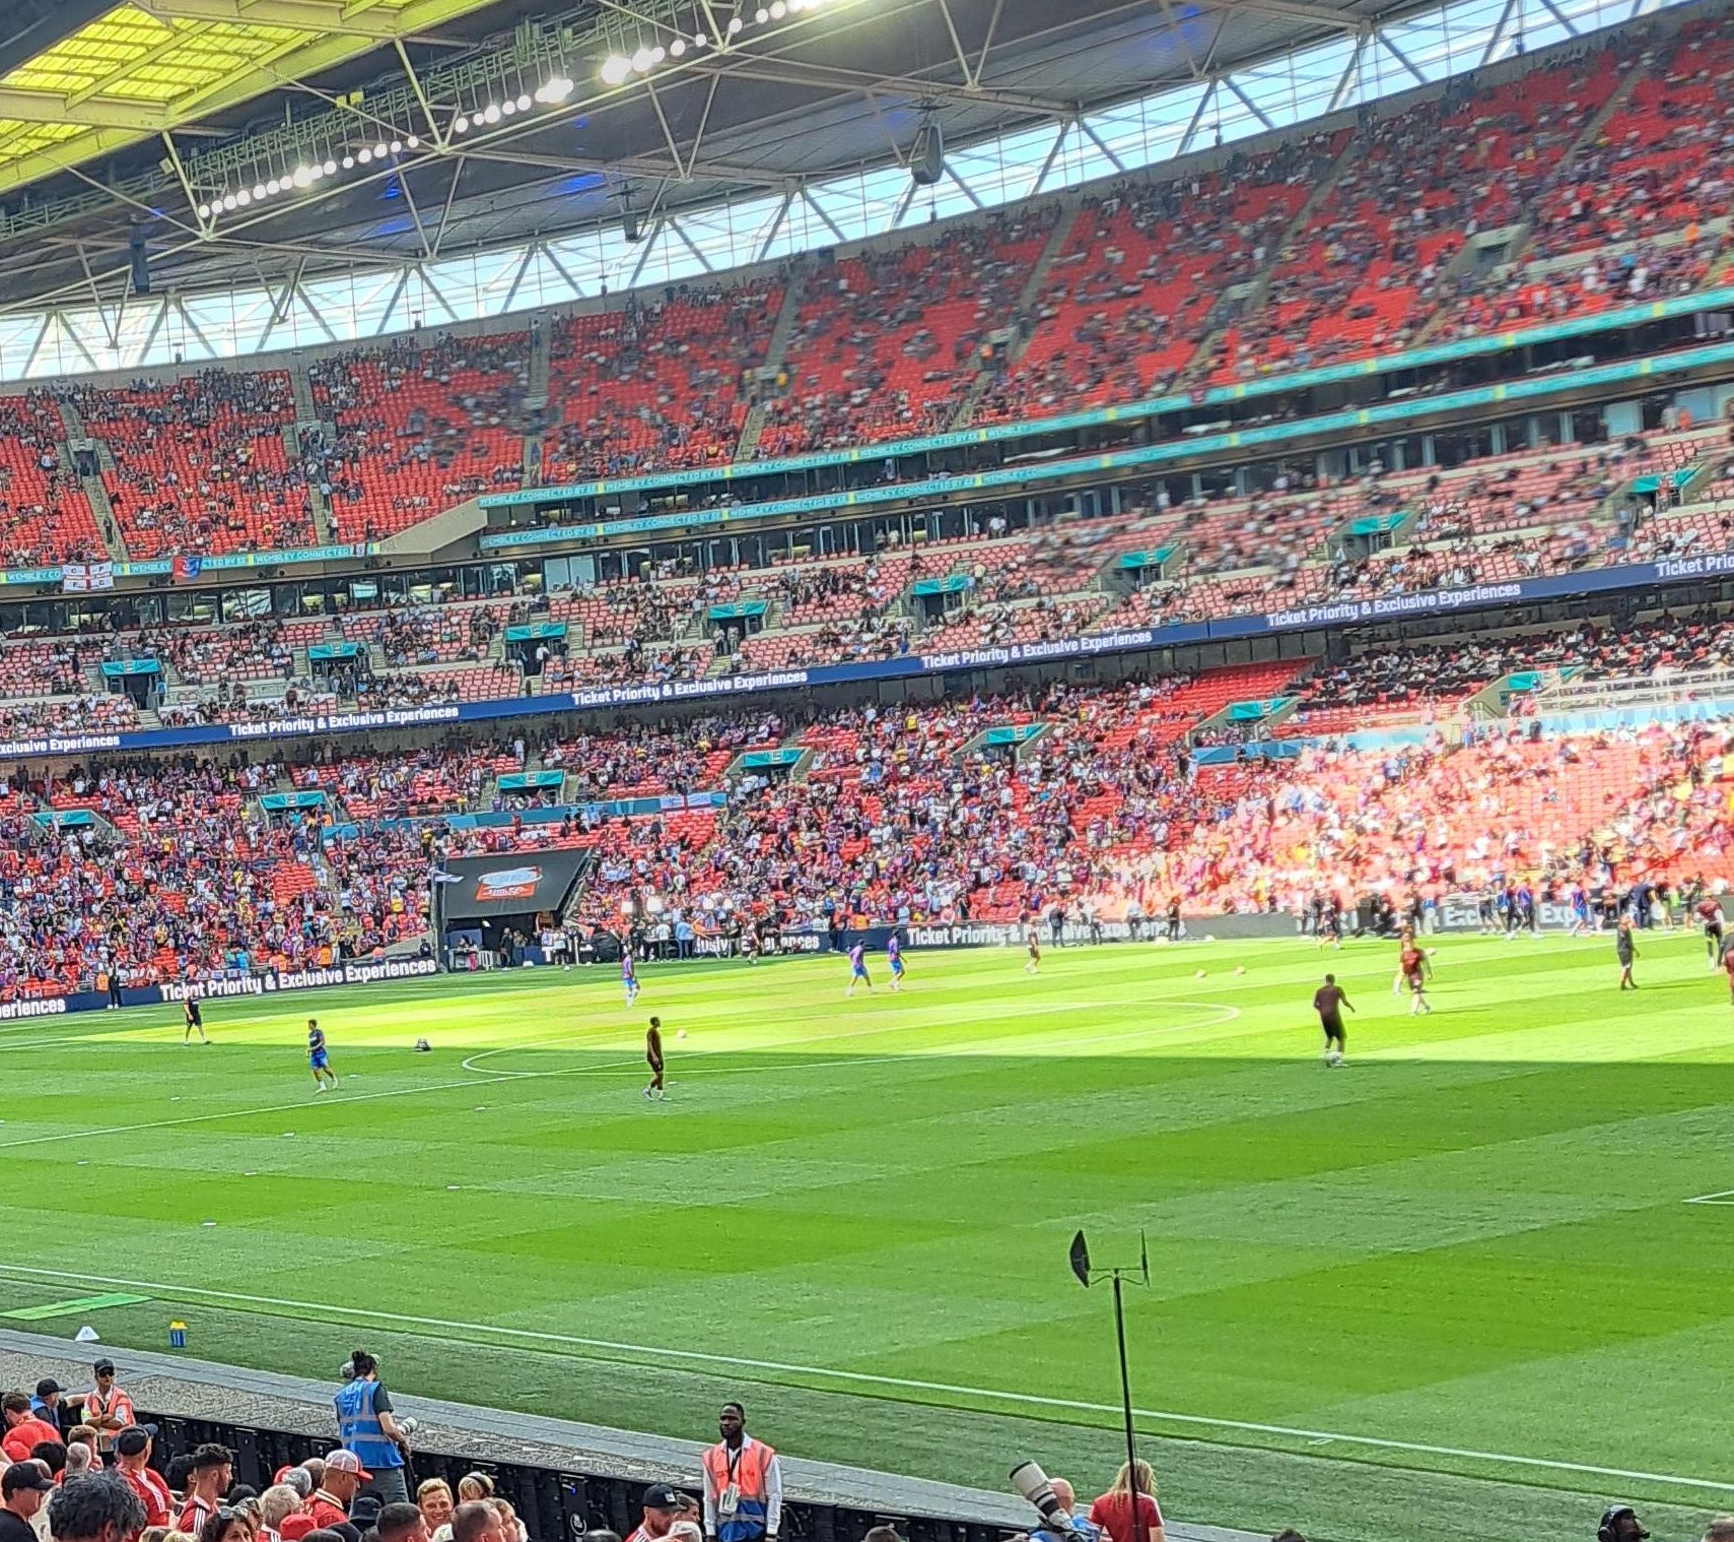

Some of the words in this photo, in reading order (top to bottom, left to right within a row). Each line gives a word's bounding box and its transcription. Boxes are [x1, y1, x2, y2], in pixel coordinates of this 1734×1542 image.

[1655, 558, 1703, 577] Ticket
[1266, 611, 1307, 627] Ticket
[1309, 604, 1359, 622] Priority
[1362, 601, 1371, 613] &
[1374, 593, 1436, 613] Exclusive
[1439, 583, 1521, 606] Experiences
[921, 654, 960, 668] Ticket
[962, 648, 1009, 665] Priority
[1011, 645, 1021, 657] &
[1023, 639, 1078, 657] Exclusive
[1081, 631, 1153, 651] Experiences
[572, 692, 611, 705] Ticket
[613, 685, 660, 702] Priority
[662, 683, 672, 696] &
[674, 679, 732, 696] Exclusive
[734, 671, 808, 690] Experiences
[229, 724, 267, 737] Ticket
[269, 719, 315, 735] Priority
[317, 717, 327, 729] &
[329, 713, 384, 729] Exclusive
[387, 706, 459, 725] Experiences
[50, 735, 120, 752] Experiences
[907, 926, 949, 945] Ticket
[208, 977, 262, 995] Priority
[265, 975, 276, 990] &
[279, 967, 344, 988] Exclusive
[346, 959, 436, 983] Experiences
